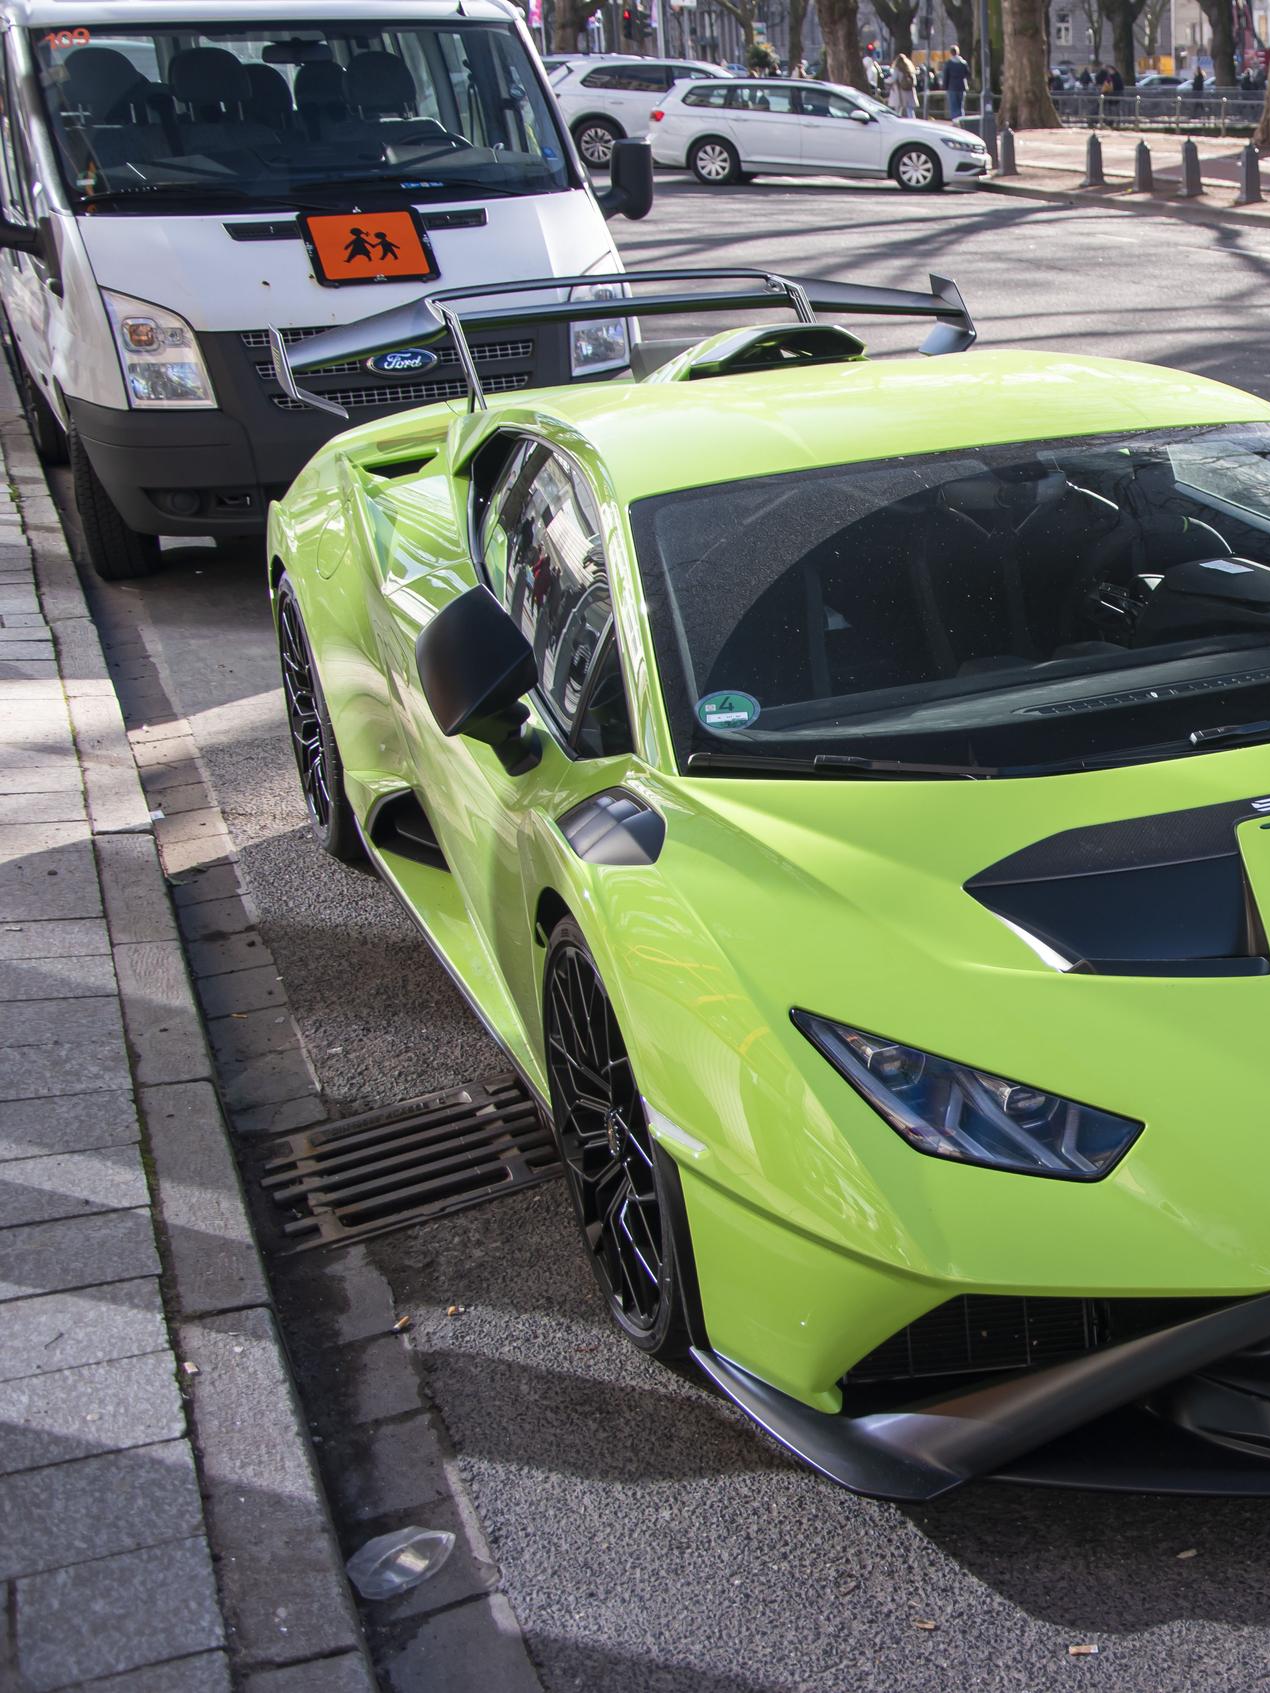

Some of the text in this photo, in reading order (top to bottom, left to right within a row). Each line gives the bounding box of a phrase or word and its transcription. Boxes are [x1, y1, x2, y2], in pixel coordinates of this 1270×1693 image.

[44, 27, 90, 50] 109
[384, 352, 422, 370] Ford
[719, 696, 735, 711] 4
